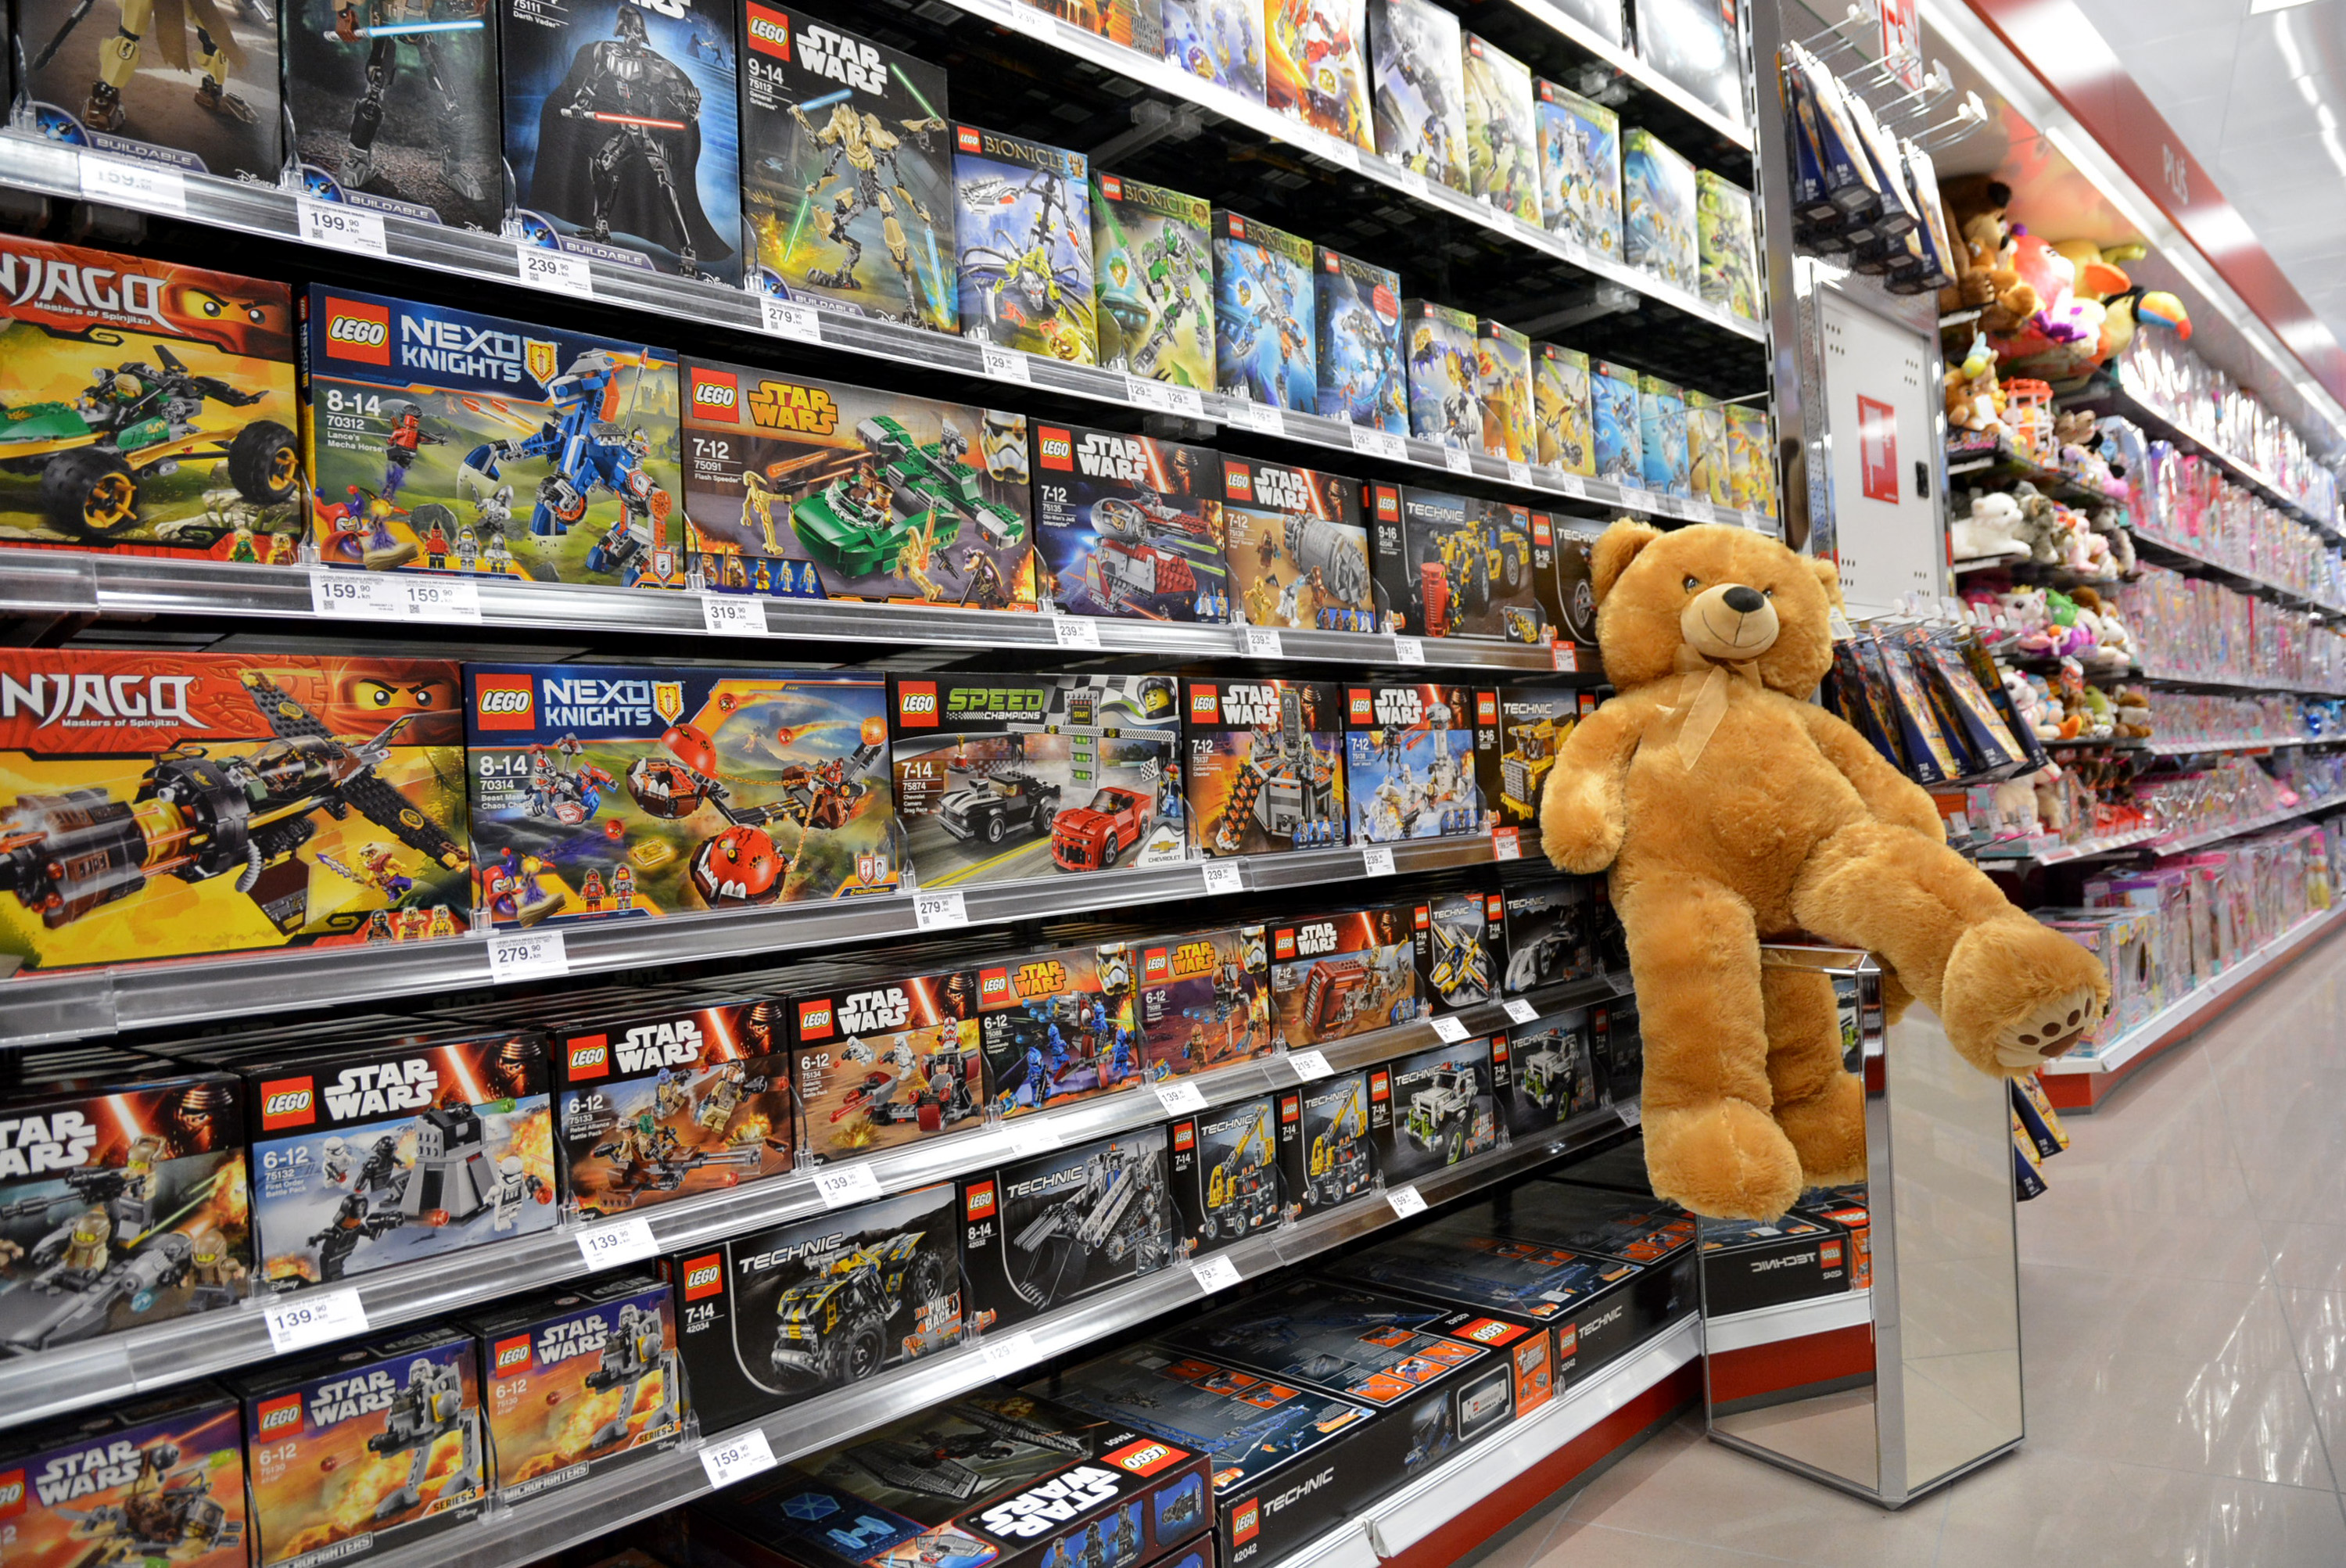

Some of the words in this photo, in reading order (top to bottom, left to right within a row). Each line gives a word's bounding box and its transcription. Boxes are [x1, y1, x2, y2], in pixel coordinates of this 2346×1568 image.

[748, 16, 787, 48] LEGO
[748, 58, 784, 84] 9-14
[96, 136, 192, 167] BUILDABLE
[984, 135, 1064, 170] BIONICLE
[350, 194, 429, 219] BUILDABLE
[1124, 183, 1191, 215] BIONICLE
[566, 241, 643, 266] BUILDABLE
[34, 300, 84, 316] Masters
[88, 310, 99, 318] of
[102, 311, 152, 326] Spinjitzu
[329, 316, 386, 346] LEGO
[400, 314, 521, 361] NEXO
[402, 343, 522, 383] KNIGHTS
[327, 389, 382, 416] 8-14
[694, 384, 736, 407] LEGO
[747, 379, 837, 411] STAR
[327, 415, 365, 430] 70312
[750, 402, 839, 436] WARS
[327, 432, 361, 442] Lance's
[328, 440, 355, 450] Mecha
[357, 442, 382, 454] Horse
[1077, 433, 1147, 461] STAR
[693, 438, 729, 460] 7-12
[1040, 439, 1070, 458] LEGO
[694, 461, 722, 472] 75091
[1078, 452, 1149, 481] WARS
[1254, 467, 1308, 492] STAR
[1041, 486, 1067, 502] 7-12
[1255, 484, 1309, 510] WARS
[1042, 502, 1062, 513] 75135
[1407, 501, 1465, 522] TECHNIC
[1228, 513, 1248, 528] 7-12
[1378, 526, 1397, 539] 9-16
[480, 689, 531, 713] LEGO
[543, 678, 650, 706] NEXO
[947, 687, 1046, 711] SPEED
[1222, 684, 1280, 707] STAR
[1375, 688, 1422, 707] STAR
[902, 694, 935, 713] LEGO
[1073, 709, 1089, 718] START
[1192, 695, 1218, 712] LEGO
[1223, 703, 1281, 724] WARS
[1375, 705, 1422, 723] WARS
[1503, 701, 1553, 716] TECHNIC
[62, 719, 100, 727] Masters
[115, 719, 126, 727] of
[130, 719, 178, 728] Spinjitzu
[545, 706, 652, 727] KNIGHTS
[983, 711, 1041, 720] CHAMPIONS
[1192, 739, 1213, 753] 7-12
[1351, 737, 1368, 751] 7-12
[480, 755, 528, 777] 8-14
[1192, 755, 1209, 764] 75137
[902, 762, 933, 780] 7-14
[480, 778, 515, 791] 70314
[902, 780, 927, 791] 75874
[1148, 854, 1181, 863] CHEVROLET
[1433, 906, 1469, 920] TECHNIC
[1507, 895, 1544, 910] TECHNIC
[1297, 922, 1336, 942] STAR
[1171, 940, 1214, 960] STAR
[1299, 936, 1337, 956] WARS
[1013, 960, 1065, 982] STAR
[1146, 955, 1166, 971] LEGO
[1174, 955, 1215, 975] WARS
[1275, 967, 1291, 980] 7-12
[982, 977, 1006, 995] LEGO
[1016, 975, 1067, 997] WARS
[838, 987, 909, 1017] STAR
[1146, 990, 1166, 1004] 6-12
[801, 1009, 831, 1029] LEGO
[839, 1006, 910, 1035] WARS
[984, 1014, 1007, 1028] 6-12
[615, 1020, 703, 1053] STAR
[570, 1047, 606, 1068] LEGO
[616, 1043, 703, 1074] WARS
[802, 1053, 830, 1071] 6-12
[324, 1057, 438, 1097] STAR
[802, 1070, 822, 1080] 75134
[802, 1079, 822, 1088] Galactic
[264, 1090, 310, 1118] LEGO
[325, 1084, 439, 1121] WARS
[569, 1095, 603, 1114] 6-12
[569, 1114, 593, 1124] 75133
[588, 1121, 610, 1131] Alliance
[570, 1132, 588, 1141] Battle
[588, 1130, 603, 1139] Pack
[263, 1146, 308, 1170] 6-12
[1174, 1154, 1192, 1168] 7-14
[265, 1168, 296, 1182] 75132
[266, 1180, 282, 1190] First
[283, 1178, 304, 1189] Order
[1007, 1164, 1083, 1197] TECHNIC
[266, 1188, 287, 1198] Battle
[289, 1186, 307, 1196] Pack
[967, 1222, 992, 1240] 8-14
[738, 1232, 843, 1274] TECHNIC
[685, 1266, 719, 1290] LEGO
[685, 1302, 716, 1323] 7-14
[924, 1308, 952, 1333] BACK
[926, 1299, 950, 1322] PULL
[537, 1314, 609, 1345] STAR
[686, 1322, 710, 1334] 42034
[1472, 1319, 1512, 1344] LEGO
[1578, 1306, 1623, 1340] TECHNIC
[497, 1346, 530, 1369] LEGO
[539, 1333, 609, 1365] WARS
[310, 1369, 396, 1408] STAR
[496, 1379, 528, 1399] 6-12
[261, 1405, 300, 1430] LEGO
[311, 1387, 397, 1428] WARS
[638, 1426, 668, 1444] SERIES
[666, 1420, 675, 1434] 3
[1103, 1431, 1136, 1448] 75101
[36, 1440, 141, 1487] STAR
[259, 1443, 296, 1467] 6-12
[1121, 1444, 1170, 1470] LEGO
[38, 1458, 142, 1508] WARS
[1263, 1466, 1334, 1517] TECHNIC
[433, 1494, 469, 1513] SERIES
[468, 1486, 477, 1501] 3
[981, 1466, 1114, 1531] WARS
[995, 1472, 1122, 1537] STAR
[1232, 1542, 1257, 1563] 42042
